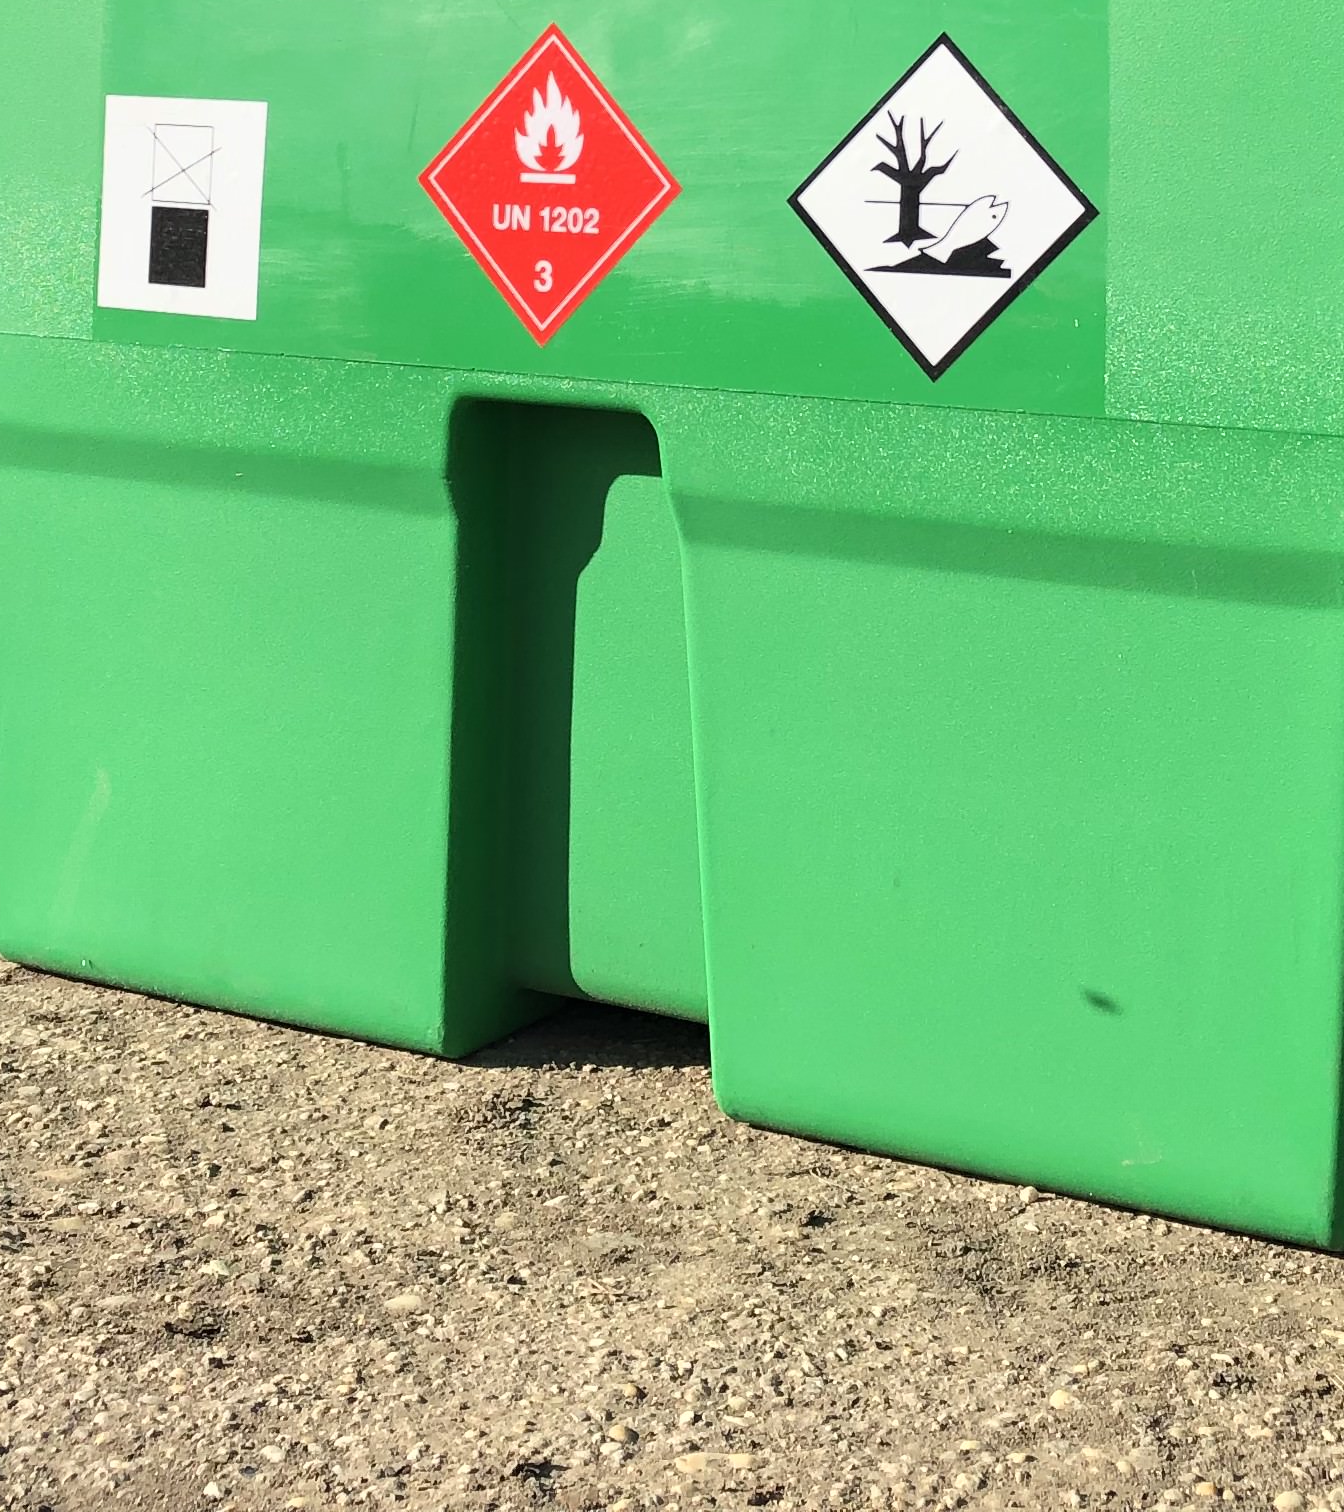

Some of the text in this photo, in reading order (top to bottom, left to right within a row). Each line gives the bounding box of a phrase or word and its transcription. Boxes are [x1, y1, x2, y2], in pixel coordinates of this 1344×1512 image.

[492, 203, 601, 235] UN 1202
[532, 259, 554, 293] 3
